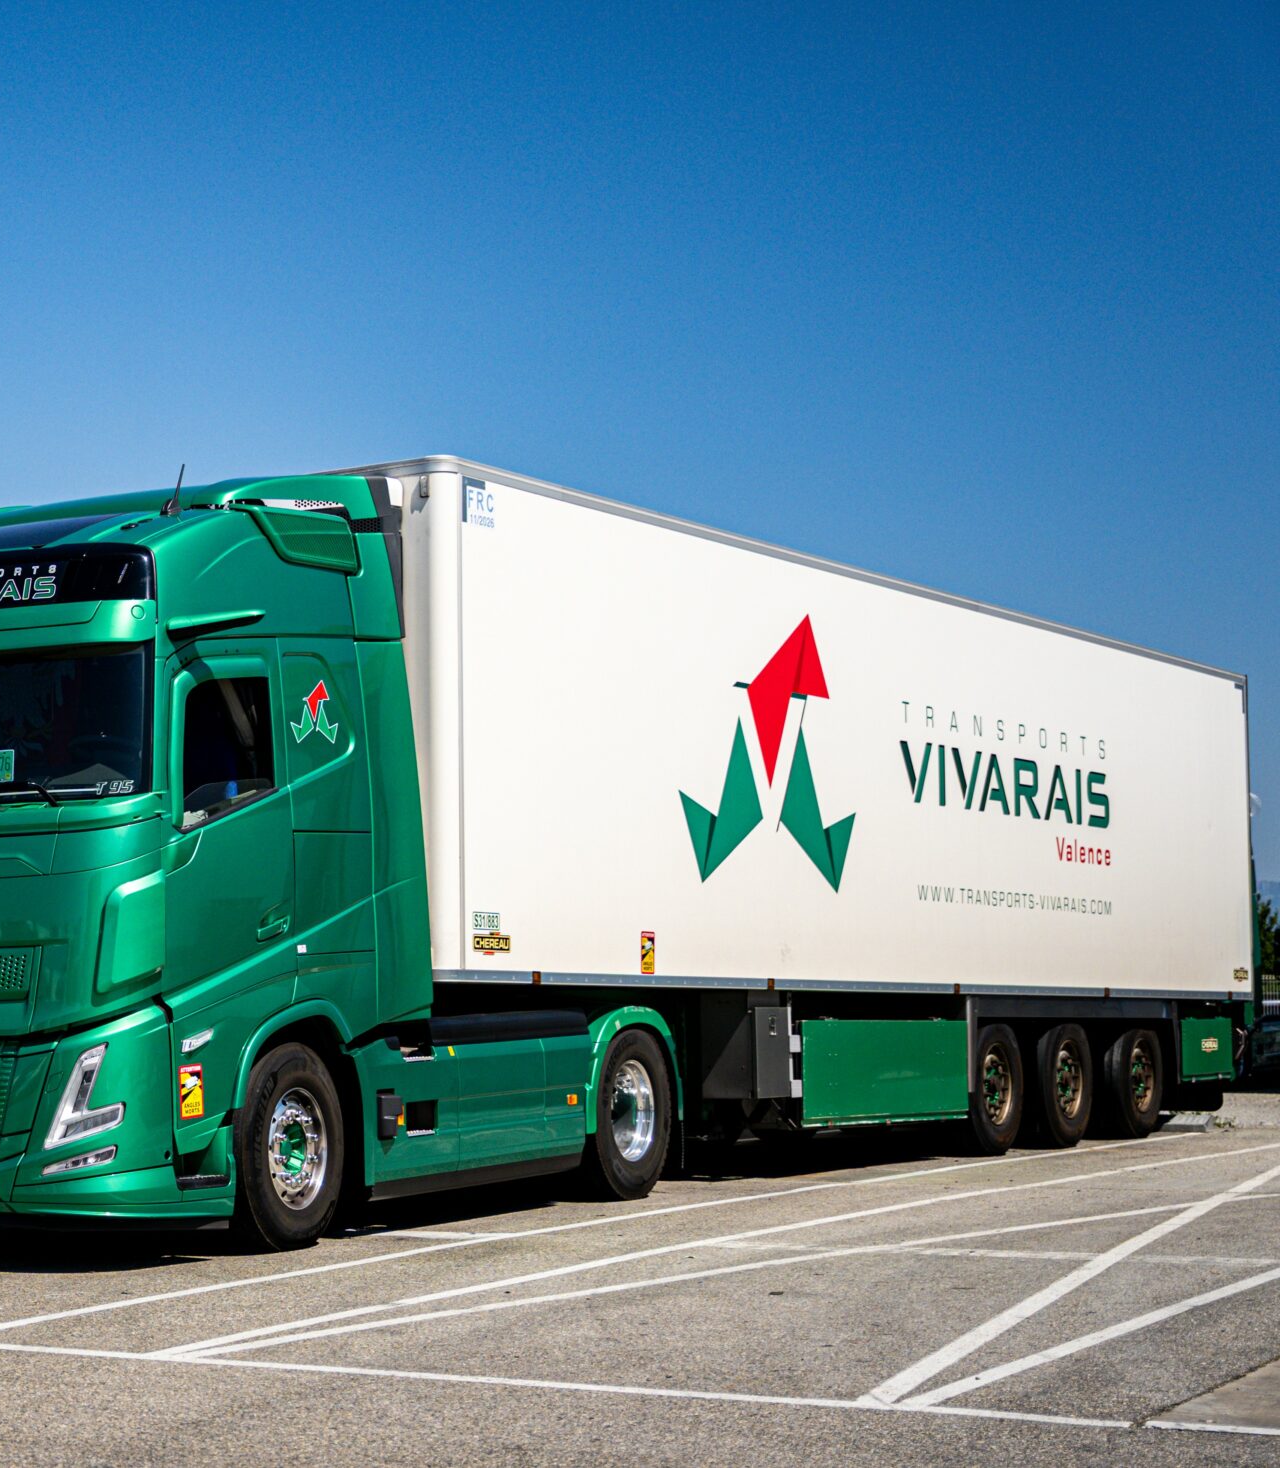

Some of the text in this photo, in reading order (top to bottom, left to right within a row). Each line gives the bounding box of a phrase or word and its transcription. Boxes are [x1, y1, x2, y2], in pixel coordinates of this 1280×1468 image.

[901, 700, 1106, 760] TRANSPORTS
[899, 740, 1110, 829] VIVARAIS
[1055, 836, 1112, 866] Valence
[917, 884, 1113, 916] WWW.TRANSPORTS-VIVARAIS.COM
[474, 937, 510, 950] CHEREAU
